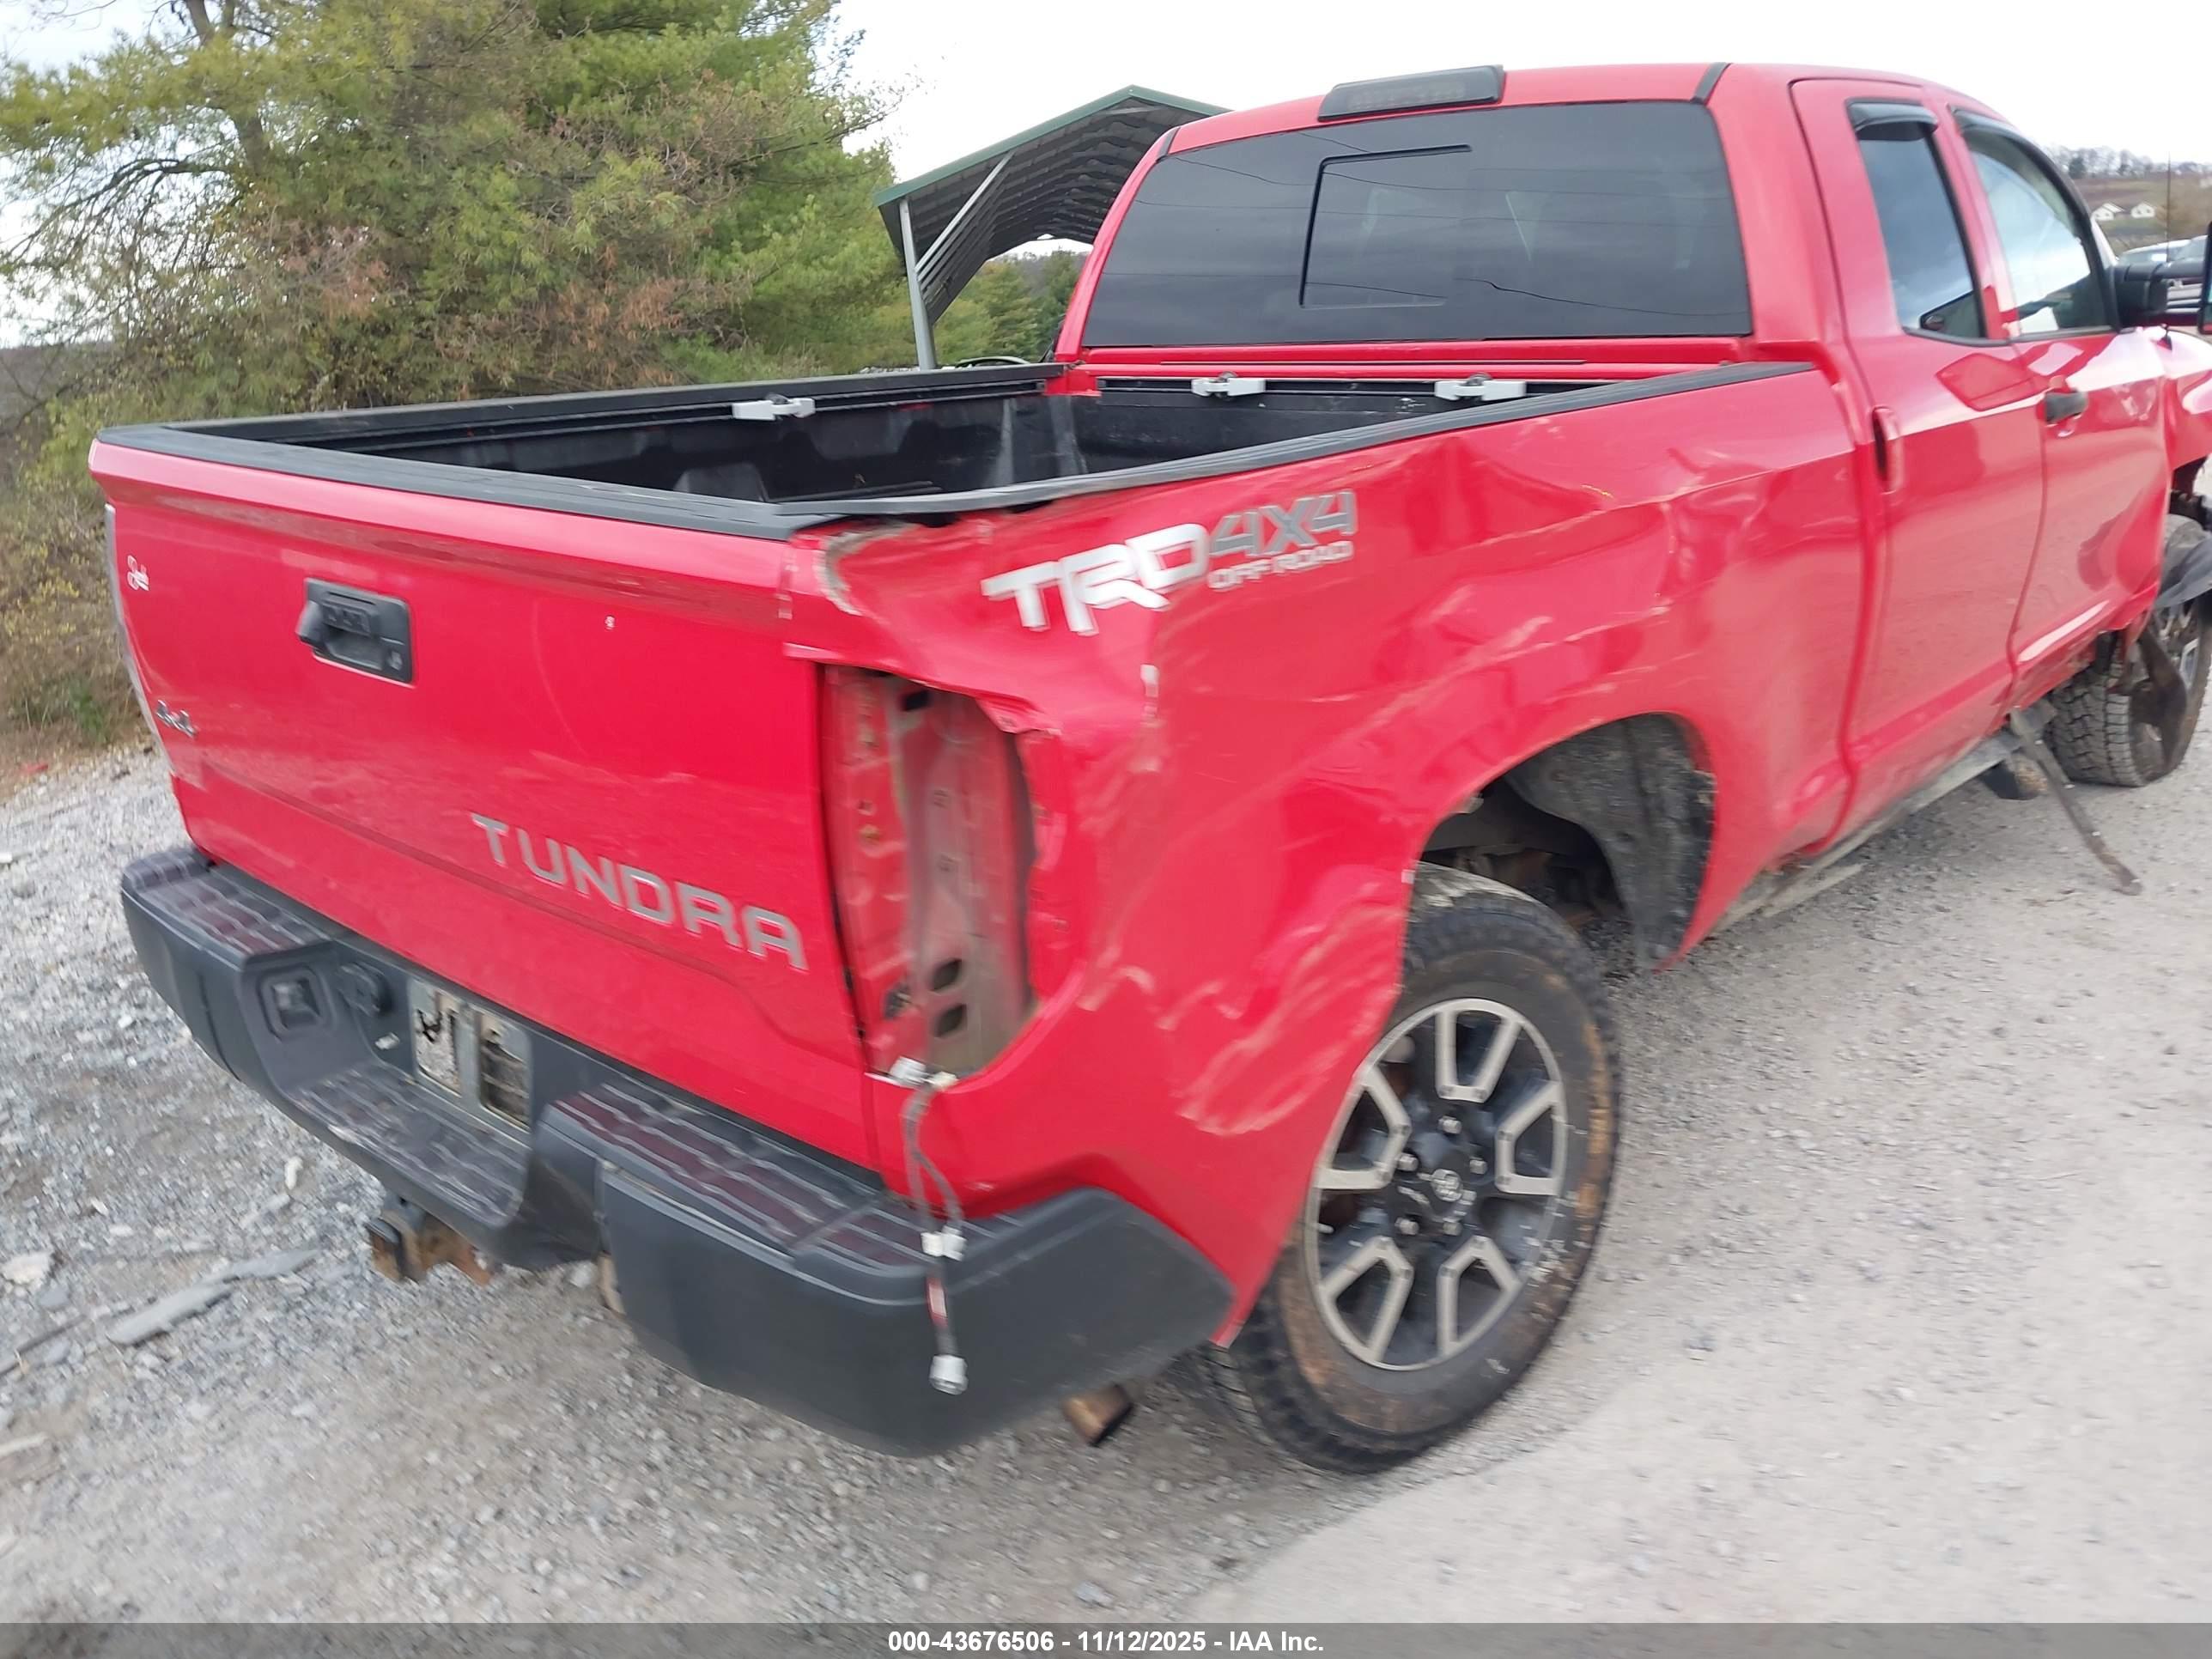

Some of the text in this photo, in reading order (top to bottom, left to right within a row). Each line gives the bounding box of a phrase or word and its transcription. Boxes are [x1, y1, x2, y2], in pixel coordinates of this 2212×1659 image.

[980, 523, 1210, 636] TRD
[1207, 540, 1354, 592] OFF ROAD
[470, 812, 809, 971] TUNDRA
